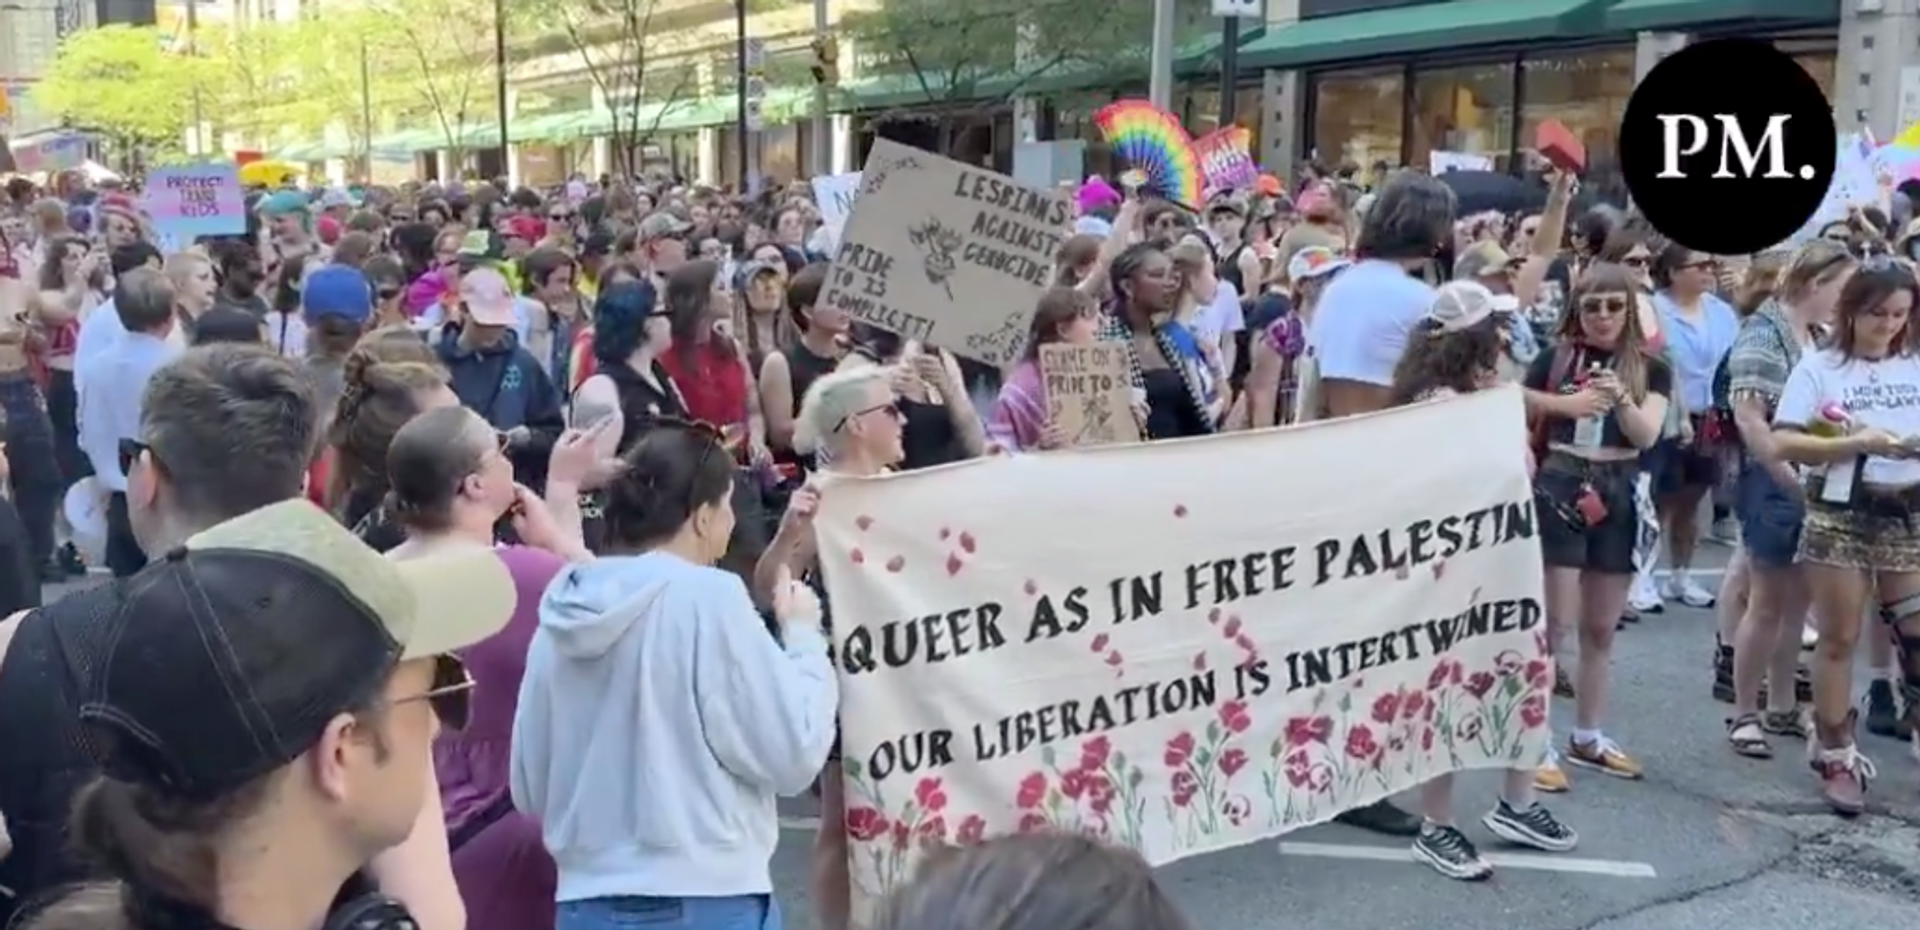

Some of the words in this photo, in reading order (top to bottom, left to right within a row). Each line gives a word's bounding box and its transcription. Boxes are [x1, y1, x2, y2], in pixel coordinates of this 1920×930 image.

[954, 171, 1068, 226] LESBIANS
[971, 210, 1061, 258] AGAINST
[833, 265, 854, 288] TO
[861, 276, 887, 298] IS
[838, 242, 895, 279] PRIDE
[963, 241, 1050, 287] GENOCIDE
[826, 288, 936, 340] COMPLICIT!
[1089, 374, 1113, 395] TO
[842, 602, 1006, 674] QUEER
[1024, 585, 1090, 643] AS
[1110, 570, 1163, 625] IN
[1184, 545, 1298, 610] FREE
[869, 728, 954, 781] OUR
[973, 669, 1216, 762] LIBERATION
[1233, 660, 1271, 701] IS
[1286, 597, 1541, 694] INTERTWINED
